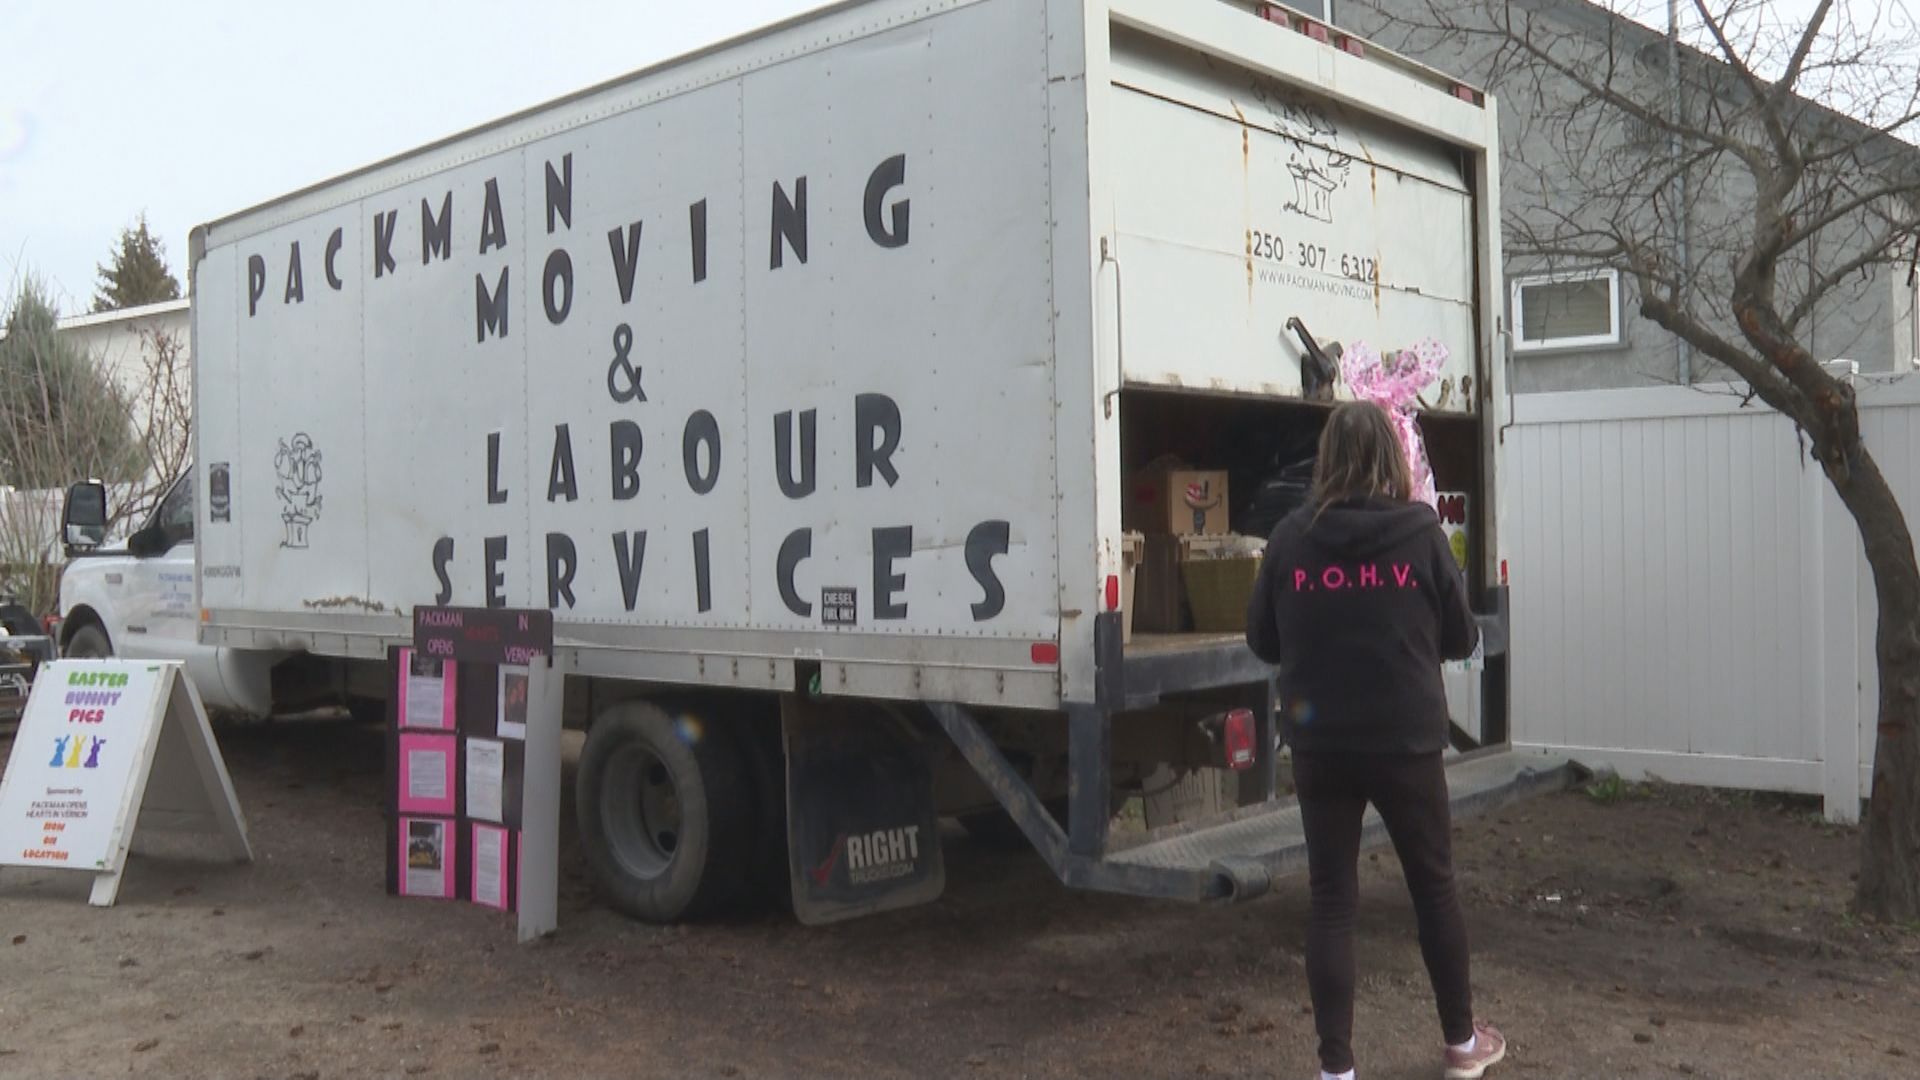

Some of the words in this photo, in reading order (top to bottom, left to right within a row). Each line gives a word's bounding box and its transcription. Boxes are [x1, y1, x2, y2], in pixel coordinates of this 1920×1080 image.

[249, 152, 572, 317] PACKMAN
[476, 153, 909, 343] MOVING
[1253, 231, 1284, 261] 250
[1298, 243, 1326, 271] 307
[1341, 253, 1374, 282] 6312
[608, 323, 647, 403] &
[487, 393, 901, 504] LABOUR
[432, 519, 1009, 621] SERVICES
[824, 592, 854, 605] DIESEL
[419, 611, 463, 627] PACKMAN
[518, 614, 529, 631] IN
[427, 638, 454, 655] OPENS
[68, 672, 128, 687] EASTER
[65, 690, 121, 706] BUNNY
[69, 709, 104, 723] PICS
[848, 825, 918, 869] RIGHT
